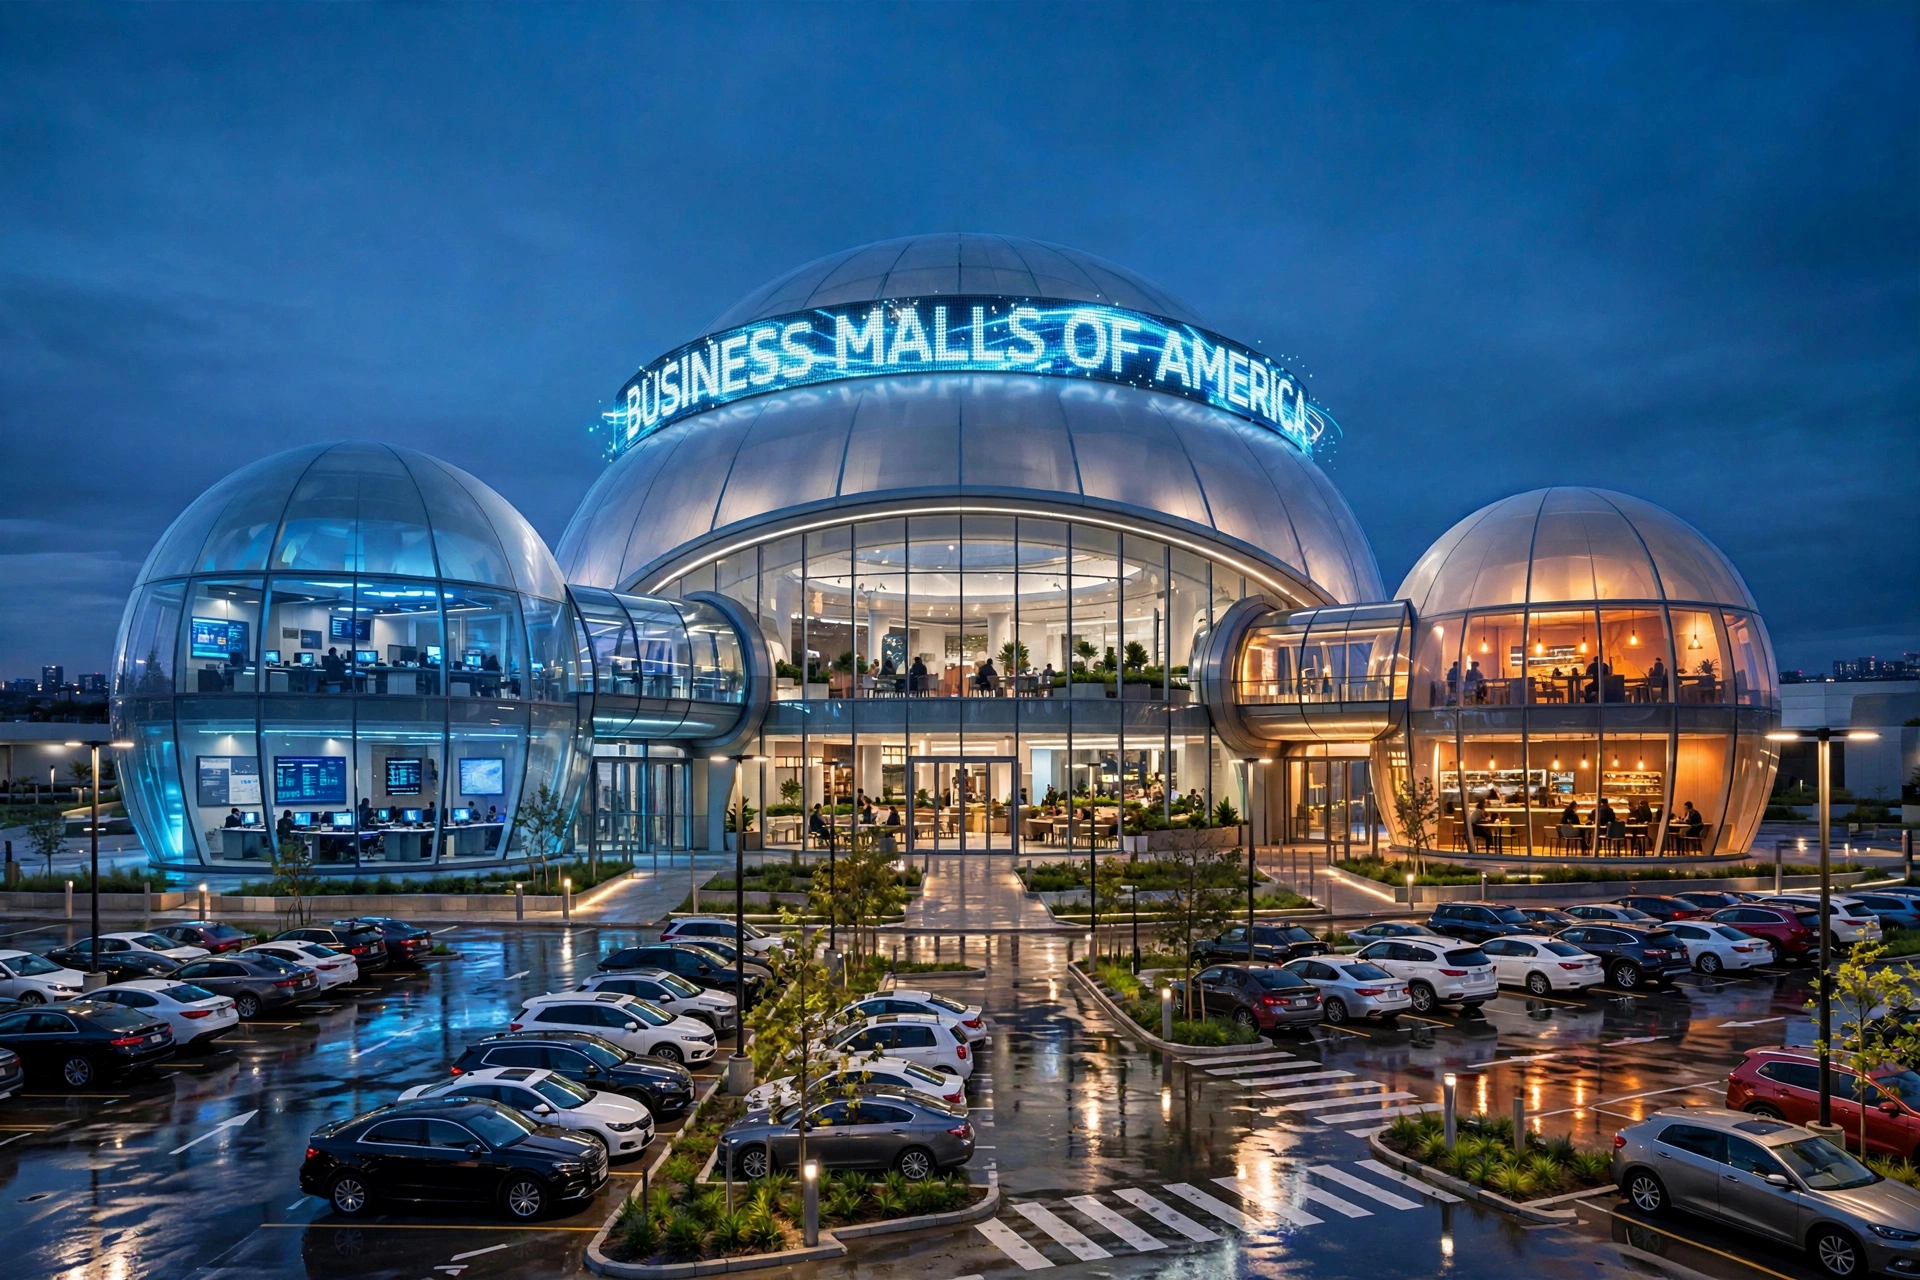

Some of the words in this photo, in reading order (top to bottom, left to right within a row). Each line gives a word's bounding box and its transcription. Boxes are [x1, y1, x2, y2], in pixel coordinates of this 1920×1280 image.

[626, 322, 813, 440] BUSINESS
[836, 306, 1045, 369] MALLS
[1064, 309, 1140, 372] OF
[1156, 331, 1307, 441] AMERICA
